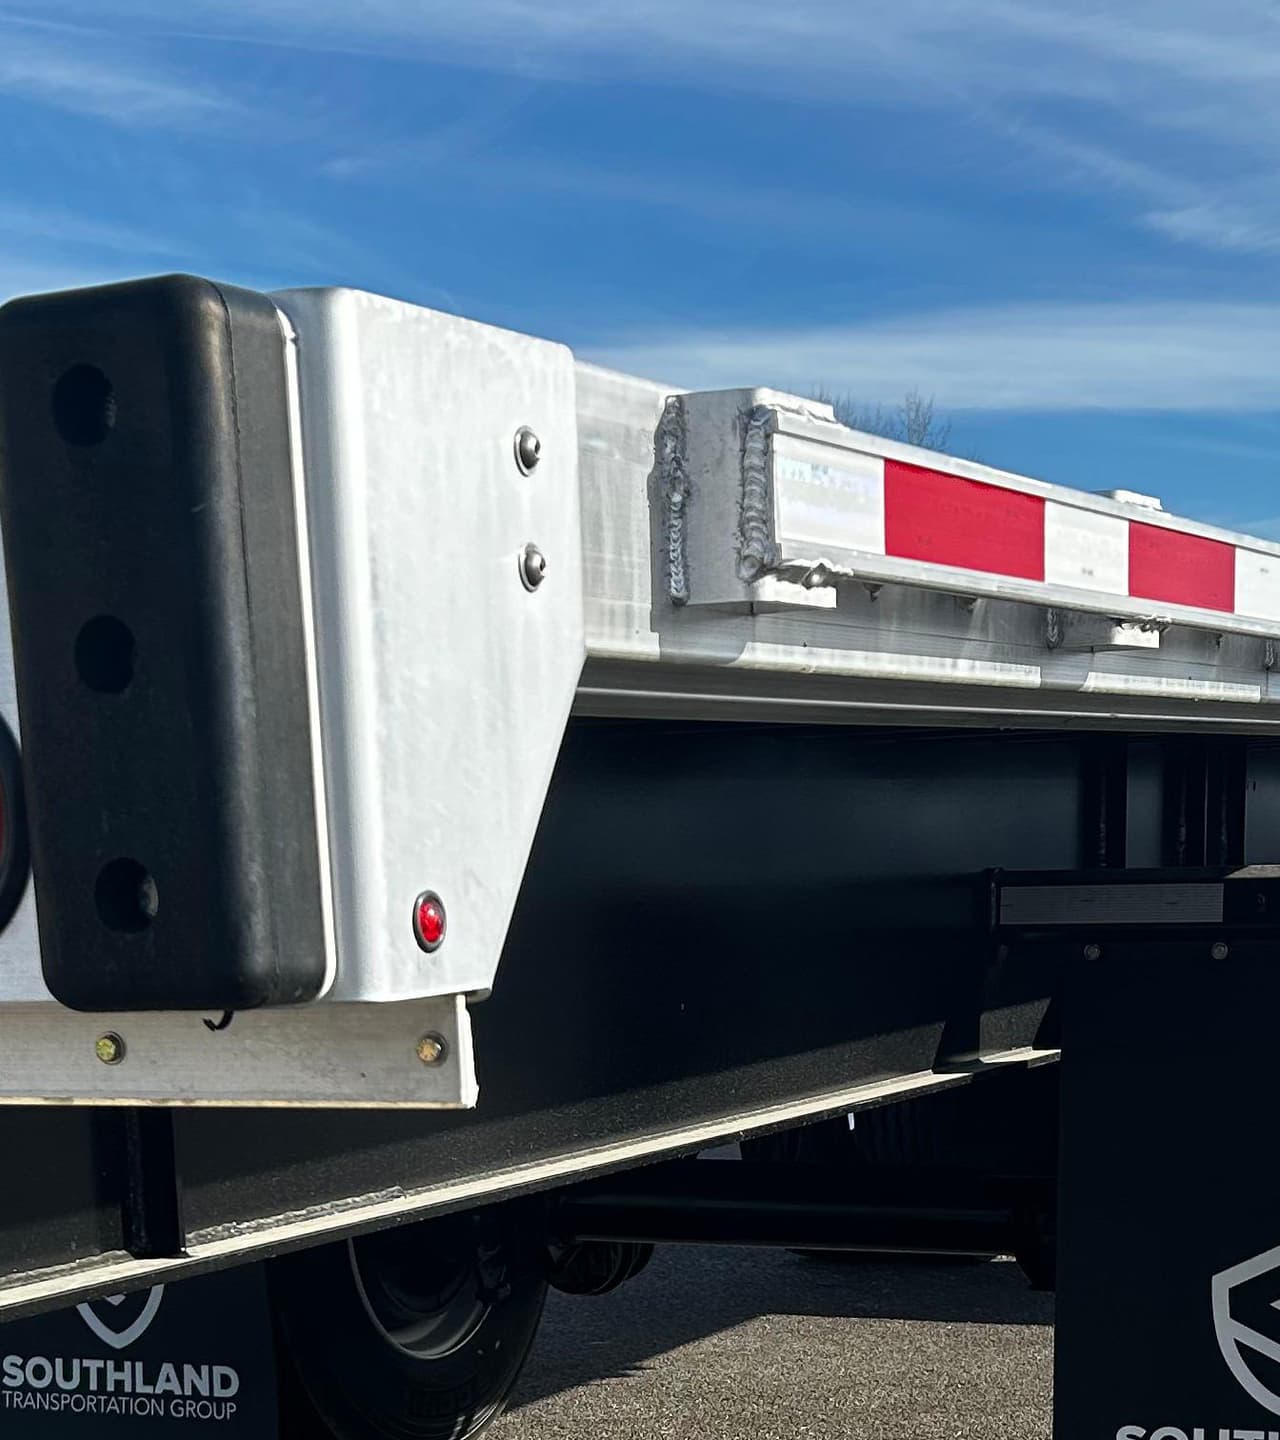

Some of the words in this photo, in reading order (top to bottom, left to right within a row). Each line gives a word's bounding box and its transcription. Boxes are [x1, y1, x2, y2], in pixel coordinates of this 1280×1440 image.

[2, 1354, 240, 1398] SOUTHLAND
[1, 1390, 164, 1417] TRANSPORTATION
[169, 1399, 237, 1420] GROUP
